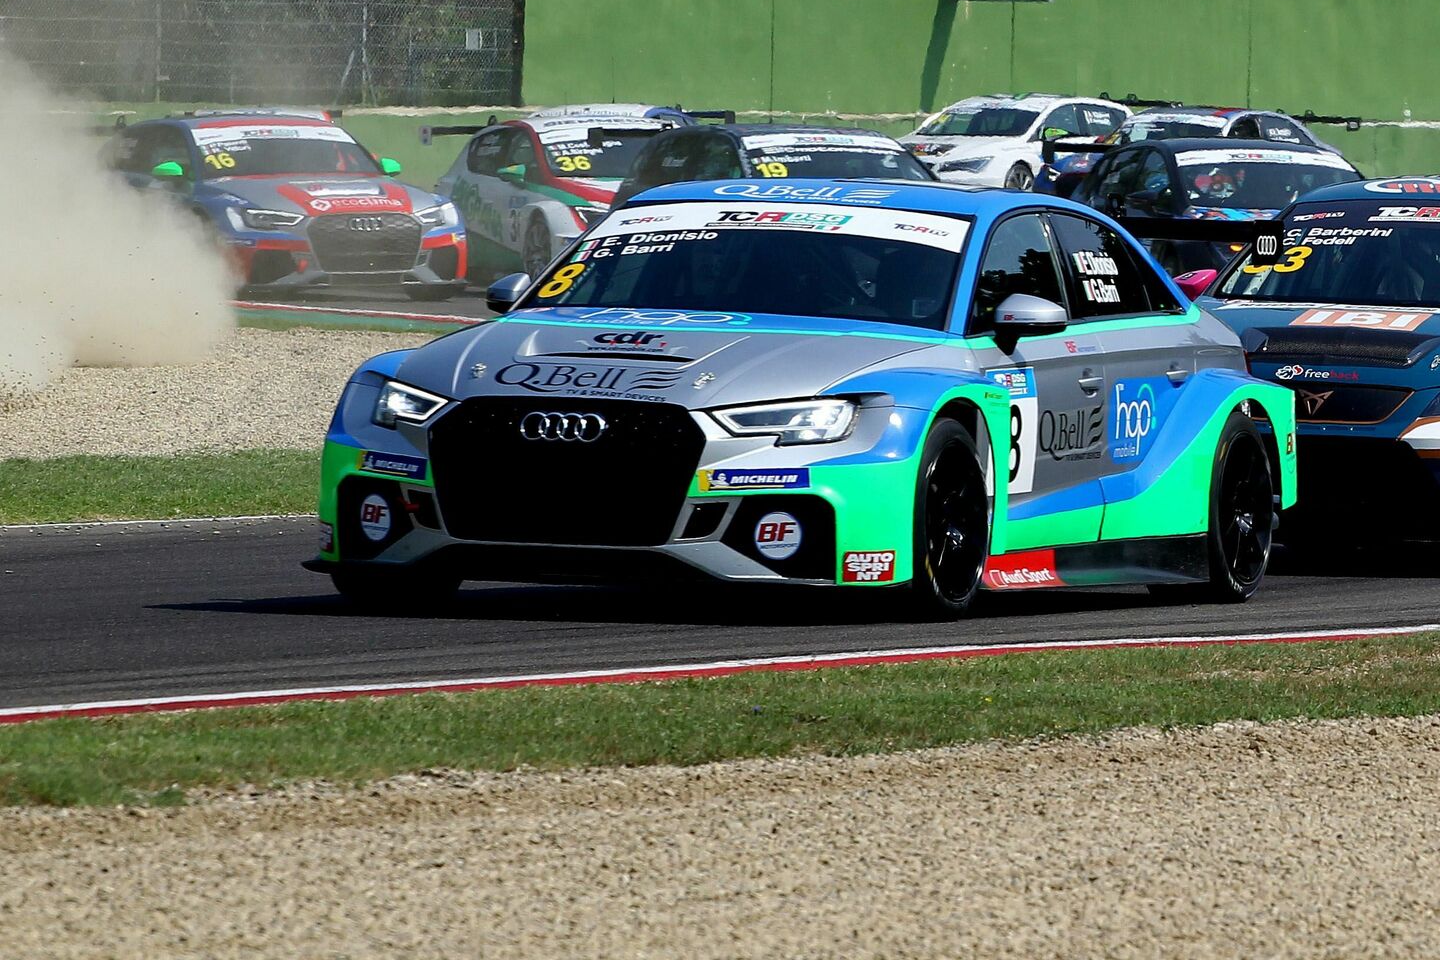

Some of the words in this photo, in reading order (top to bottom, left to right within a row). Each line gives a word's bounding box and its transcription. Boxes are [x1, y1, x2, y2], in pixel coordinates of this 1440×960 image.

[205, 153, 235, 170] 16
[555, 155, 592, 172] 36
[756, 162, 788, 178] 19
[332, 198, 403, 207] ecoclima
[717, 211, 786, 222] TCR
[601, 236, 622, 247] E.
[629, 230, 719, 245] Dionisio
[1308, 226, 1394, 238] Barberini
[1301, 236, 1356, 246] Fedeli
[593, 248, 614, 259] G.
[621, 243, 676, 256] Barri
[537, 263, 586, 298] 8
[1305, 311, 1417, 328] IBI
[593, 331, 664, 345] cdr
[494, 363, 627, 393] Q.Bell
[589, 390, 623, 400] SMART
[625, 393, 667, 403] DEVICES
[1115, 384, 1151, 455] hop
[1039, 409, 1085, 461] Q.Bell
[375, 459, 420, 472] MICHELIN
[730, 474, 798, 484] MICHELIN
[362, 503, 390, 524] BF
[757, 521, 797, 543] BF
[845, 552, 894, 563] AUTO
[847, 562, 890, 572] SPRI
[856, 571, 882, 581] NT
[1003, 570, 1024, 583] Audi
[1025, 568, 1054, 583] Sport
